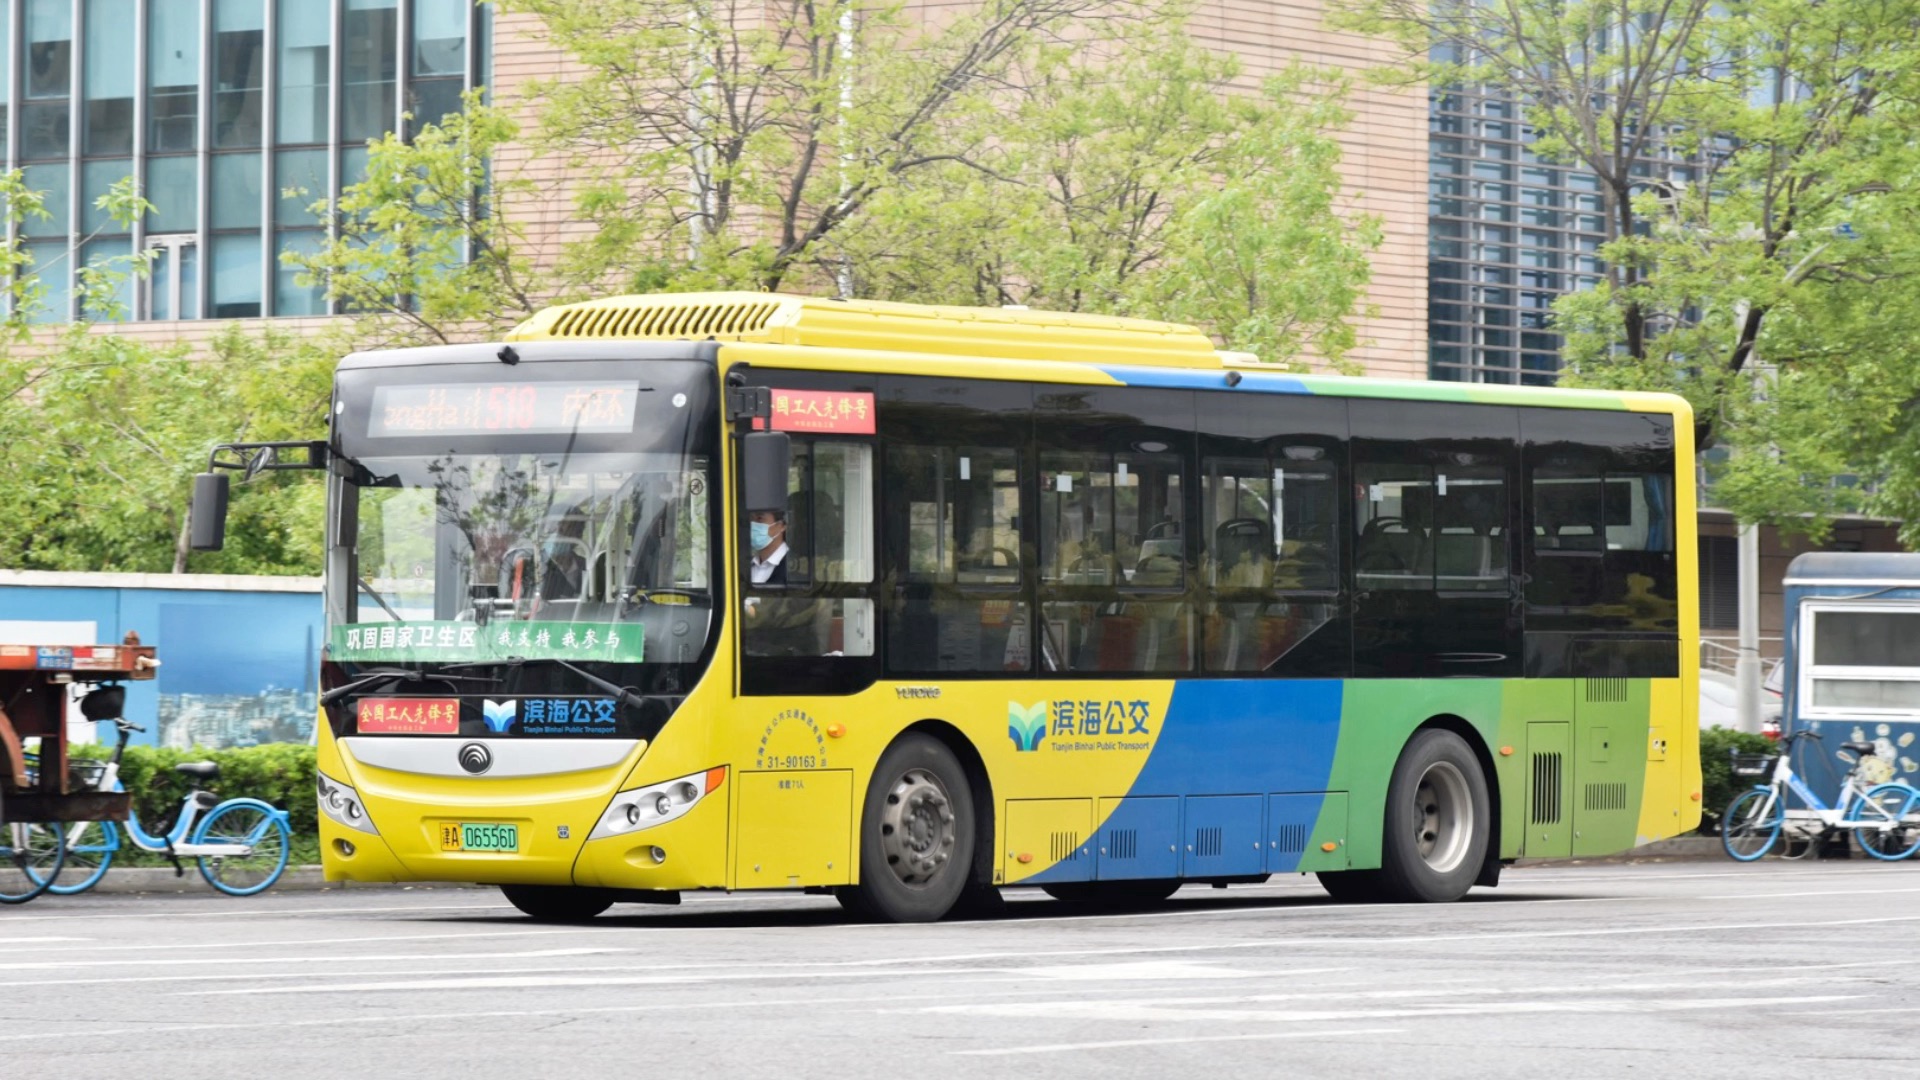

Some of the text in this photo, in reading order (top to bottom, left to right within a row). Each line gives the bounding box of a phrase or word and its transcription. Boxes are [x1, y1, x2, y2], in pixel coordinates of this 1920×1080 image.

[771, 395, 868, 420] 国工人先锋号
[346, 626, 621, 649] 巩固国家卫生区 我支持 我参与
[895, 687, 942, 699] YUTONG
[360, 703, 456, 725] 全国工人先锋号
[523, 699, 616, 723] 滨海公交
[1052, 700, 1150, 735] 滨海公交
[584, 726, 616, 734] Transport
[1052, 742, 1149, 752] Tianjin Binhai Public Transport
[768, 756, 816, 768] 31-90163
[465, 828, 516, 848] 06556D
